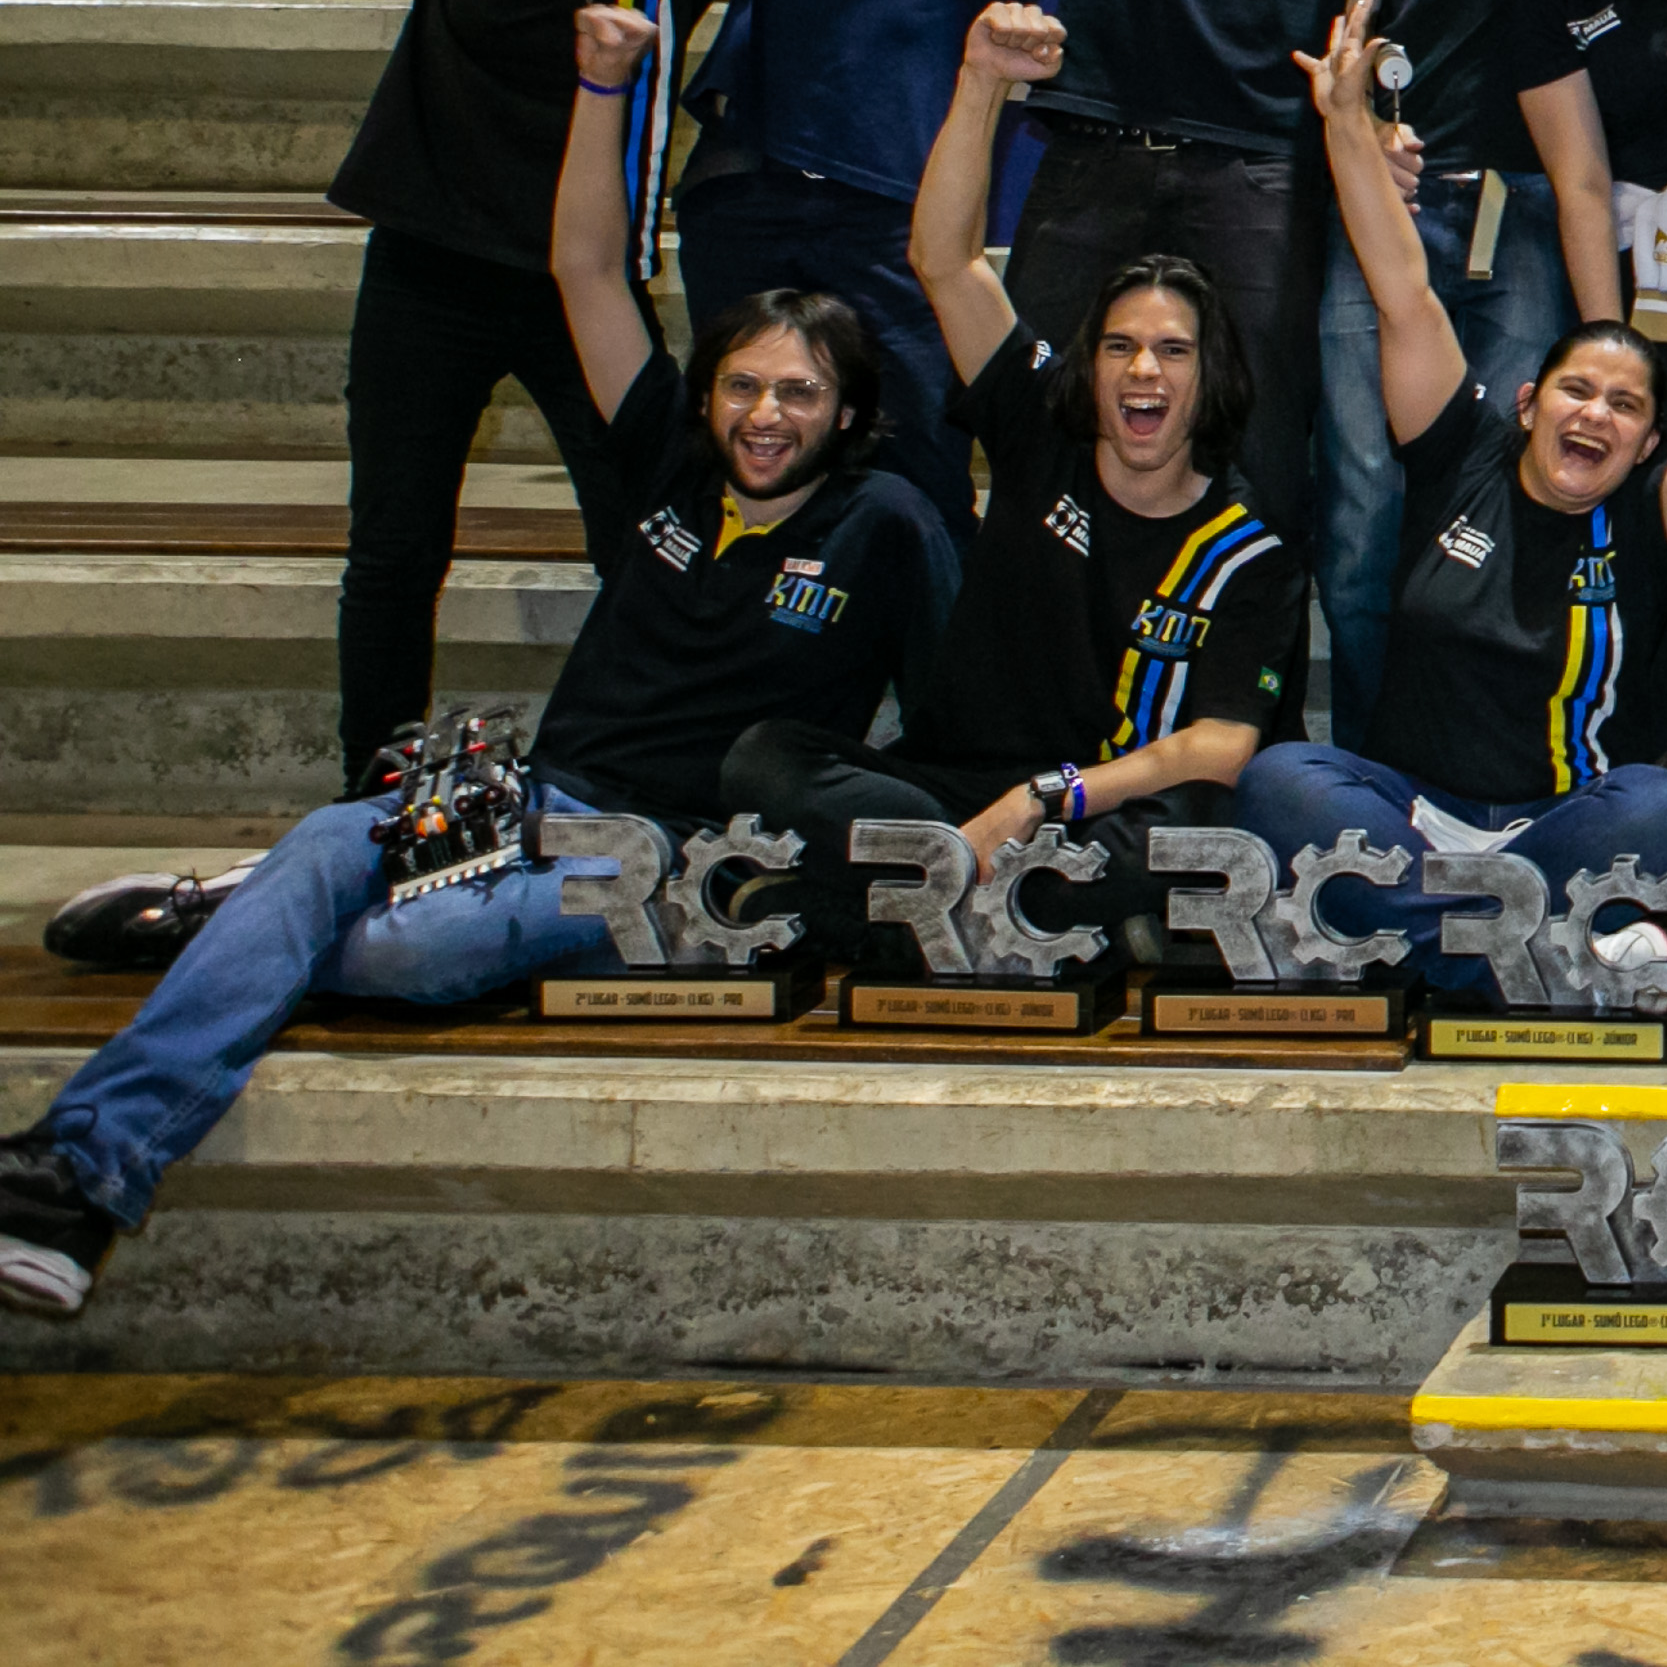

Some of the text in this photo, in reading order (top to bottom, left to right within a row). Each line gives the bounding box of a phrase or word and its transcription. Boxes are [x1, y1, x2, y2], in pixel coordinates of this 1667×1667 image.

[588, 993, 618, 1006] LUGAR
[724, 993, 743, 1006] PRO
[888, 1000, 918, 1013] LUGAR
[1200, 1009, 1230, 1021] LUGAR
[1336, 1009, 1355, 1022] PRO
[1466, 1030, 1497, 1042] LUGAR
[1553, 1314, 1585, 1328] LUGAR
